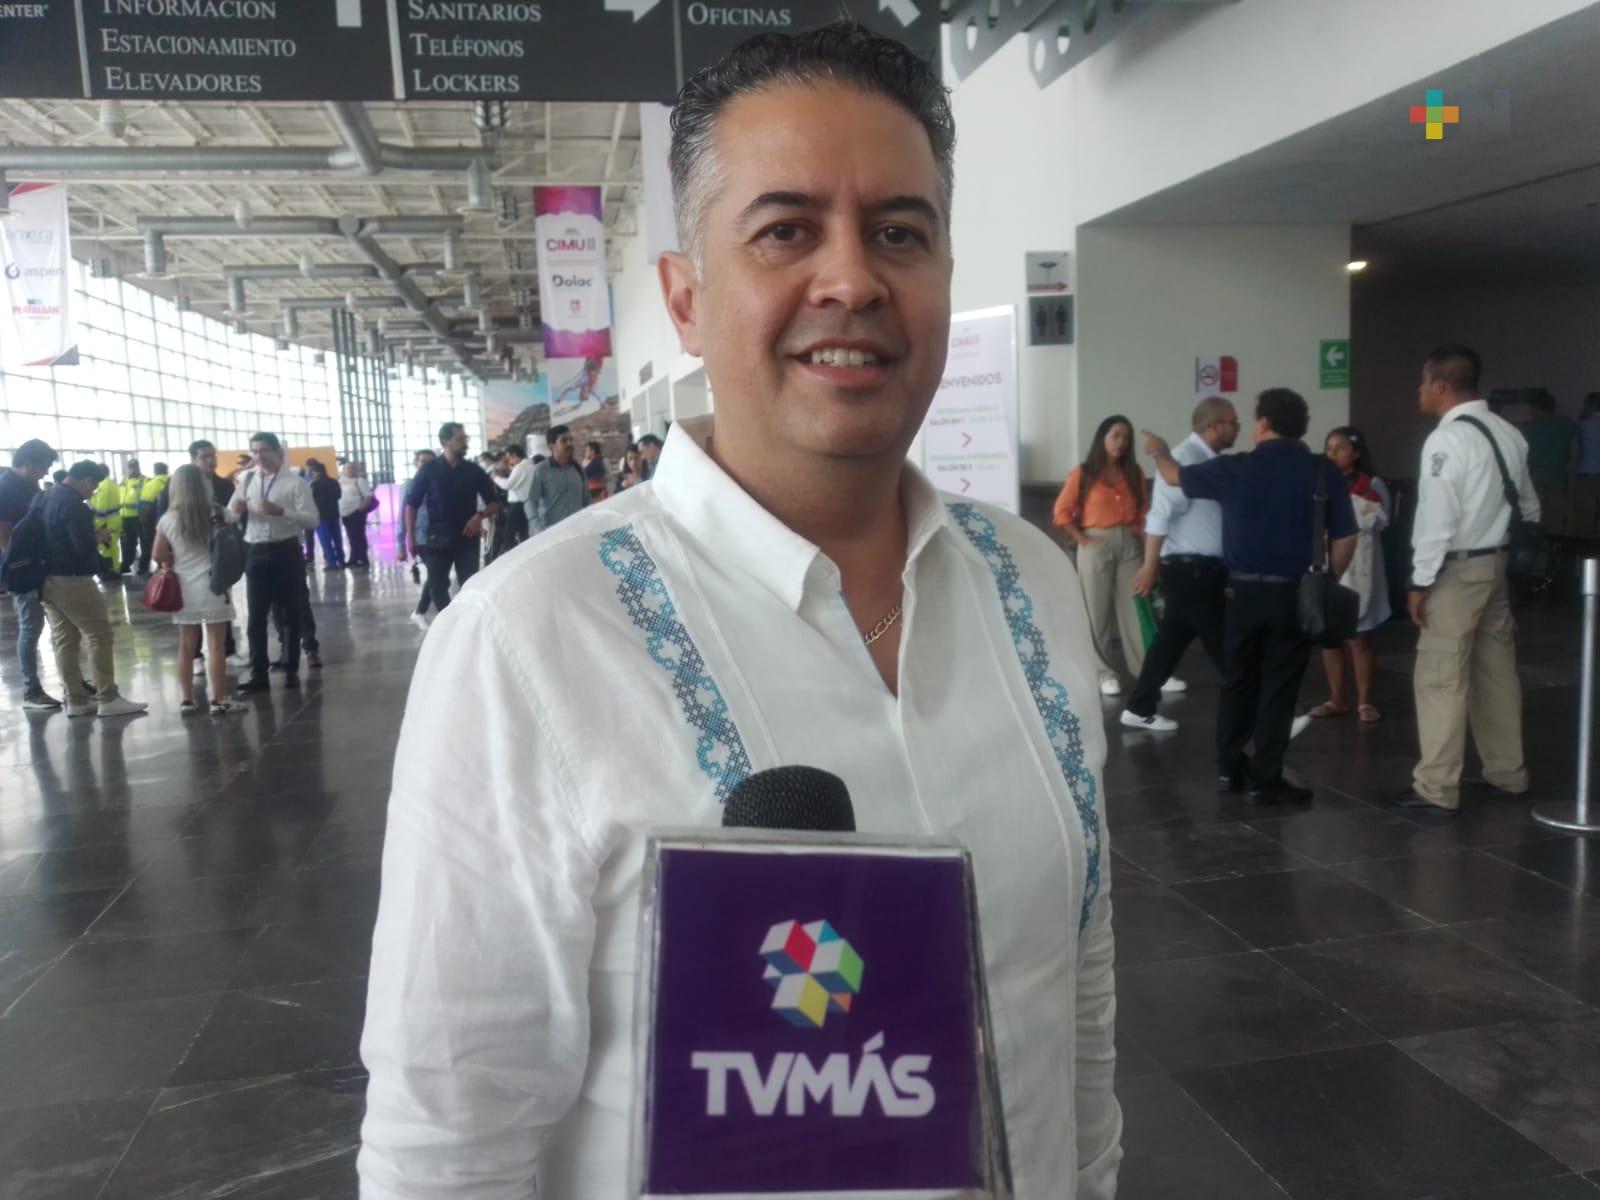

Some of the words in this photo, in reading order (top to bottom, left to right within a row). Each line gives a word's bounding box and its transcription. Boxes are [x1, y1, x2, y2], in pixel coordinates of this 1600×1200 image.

[688, 2, 792, 26] OFICINAS
[101, 28, 297, 57] ESTACIONAMIENTO
[409, 33, 525, 57] TELÉFONOS
[105, 66, 263, 93] ELEVADORES
[413, 69, 521, 92] LOCKERS
[940, 373, 1002, 390] ENVENIDOS
[691, 1030, 936, 1117] TVMÁS
